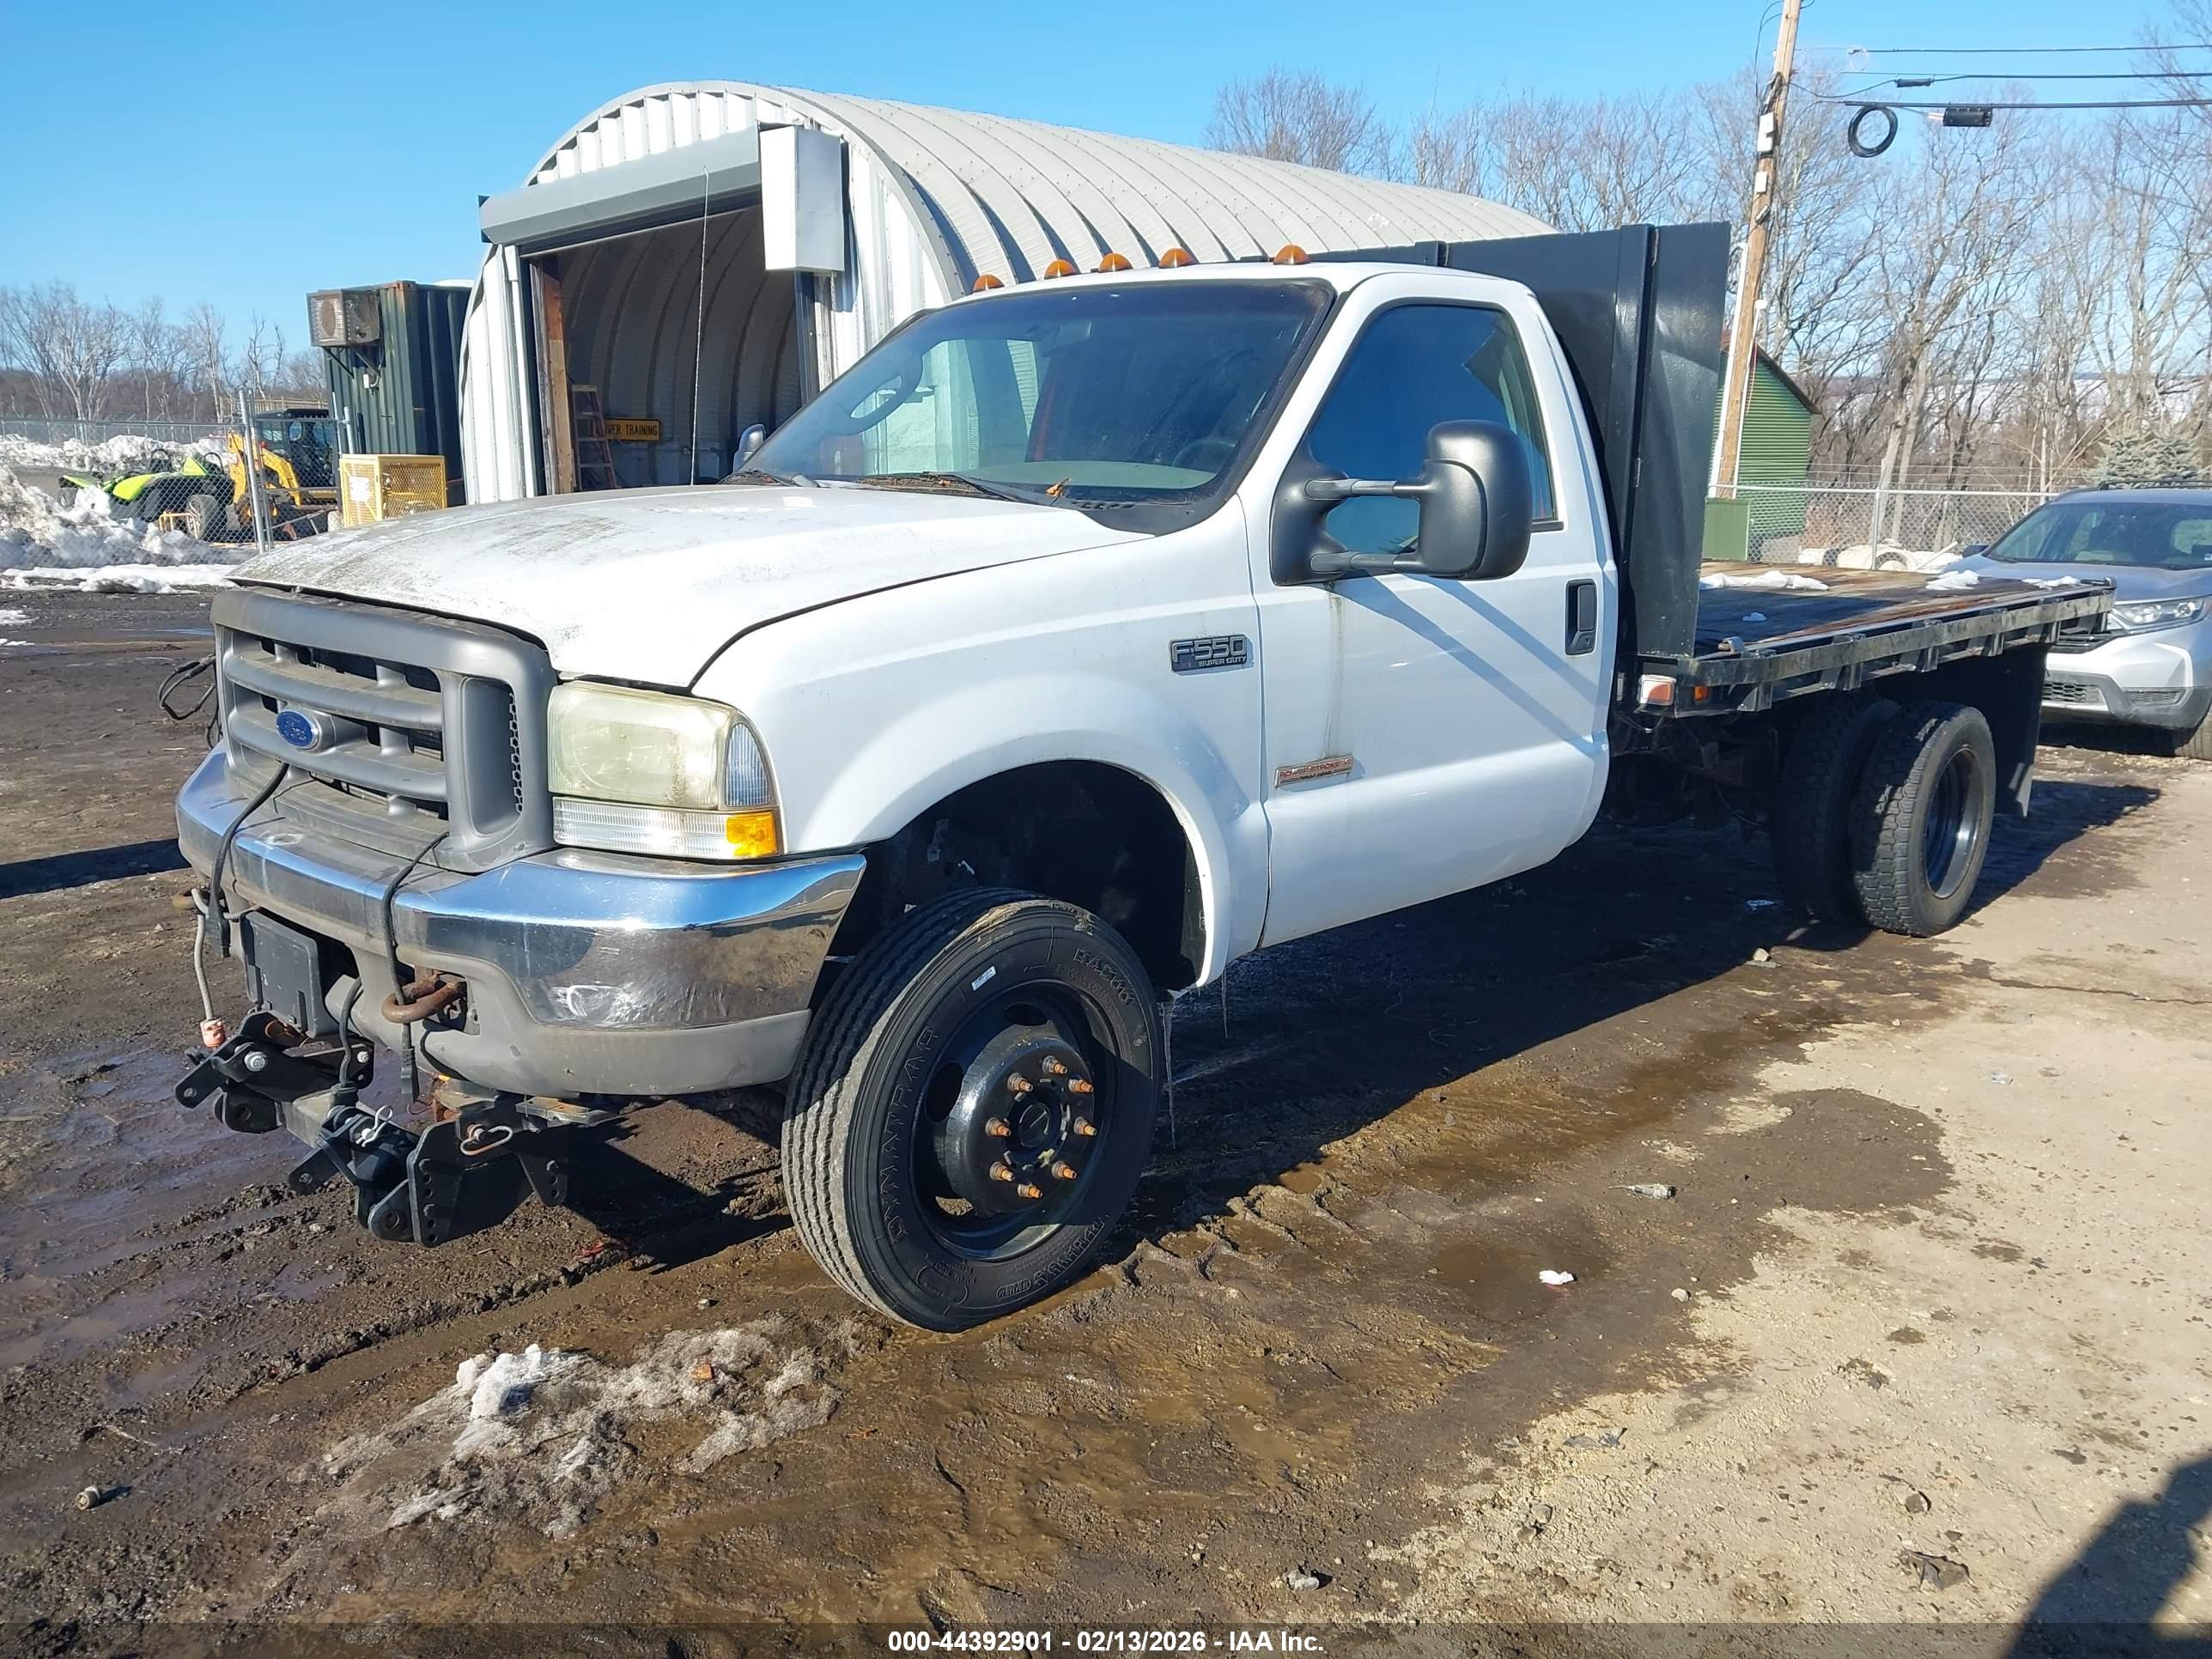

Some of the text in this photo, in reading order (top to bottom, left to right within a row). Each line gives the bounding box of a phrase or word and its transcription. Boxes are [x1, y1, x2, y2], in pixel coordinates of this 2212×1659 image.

[605, 424, 659, 435] IVER TRAINING
[1171, 636, 1247, 663] F-550
[1198, 659, 1225, 667] SUPER
